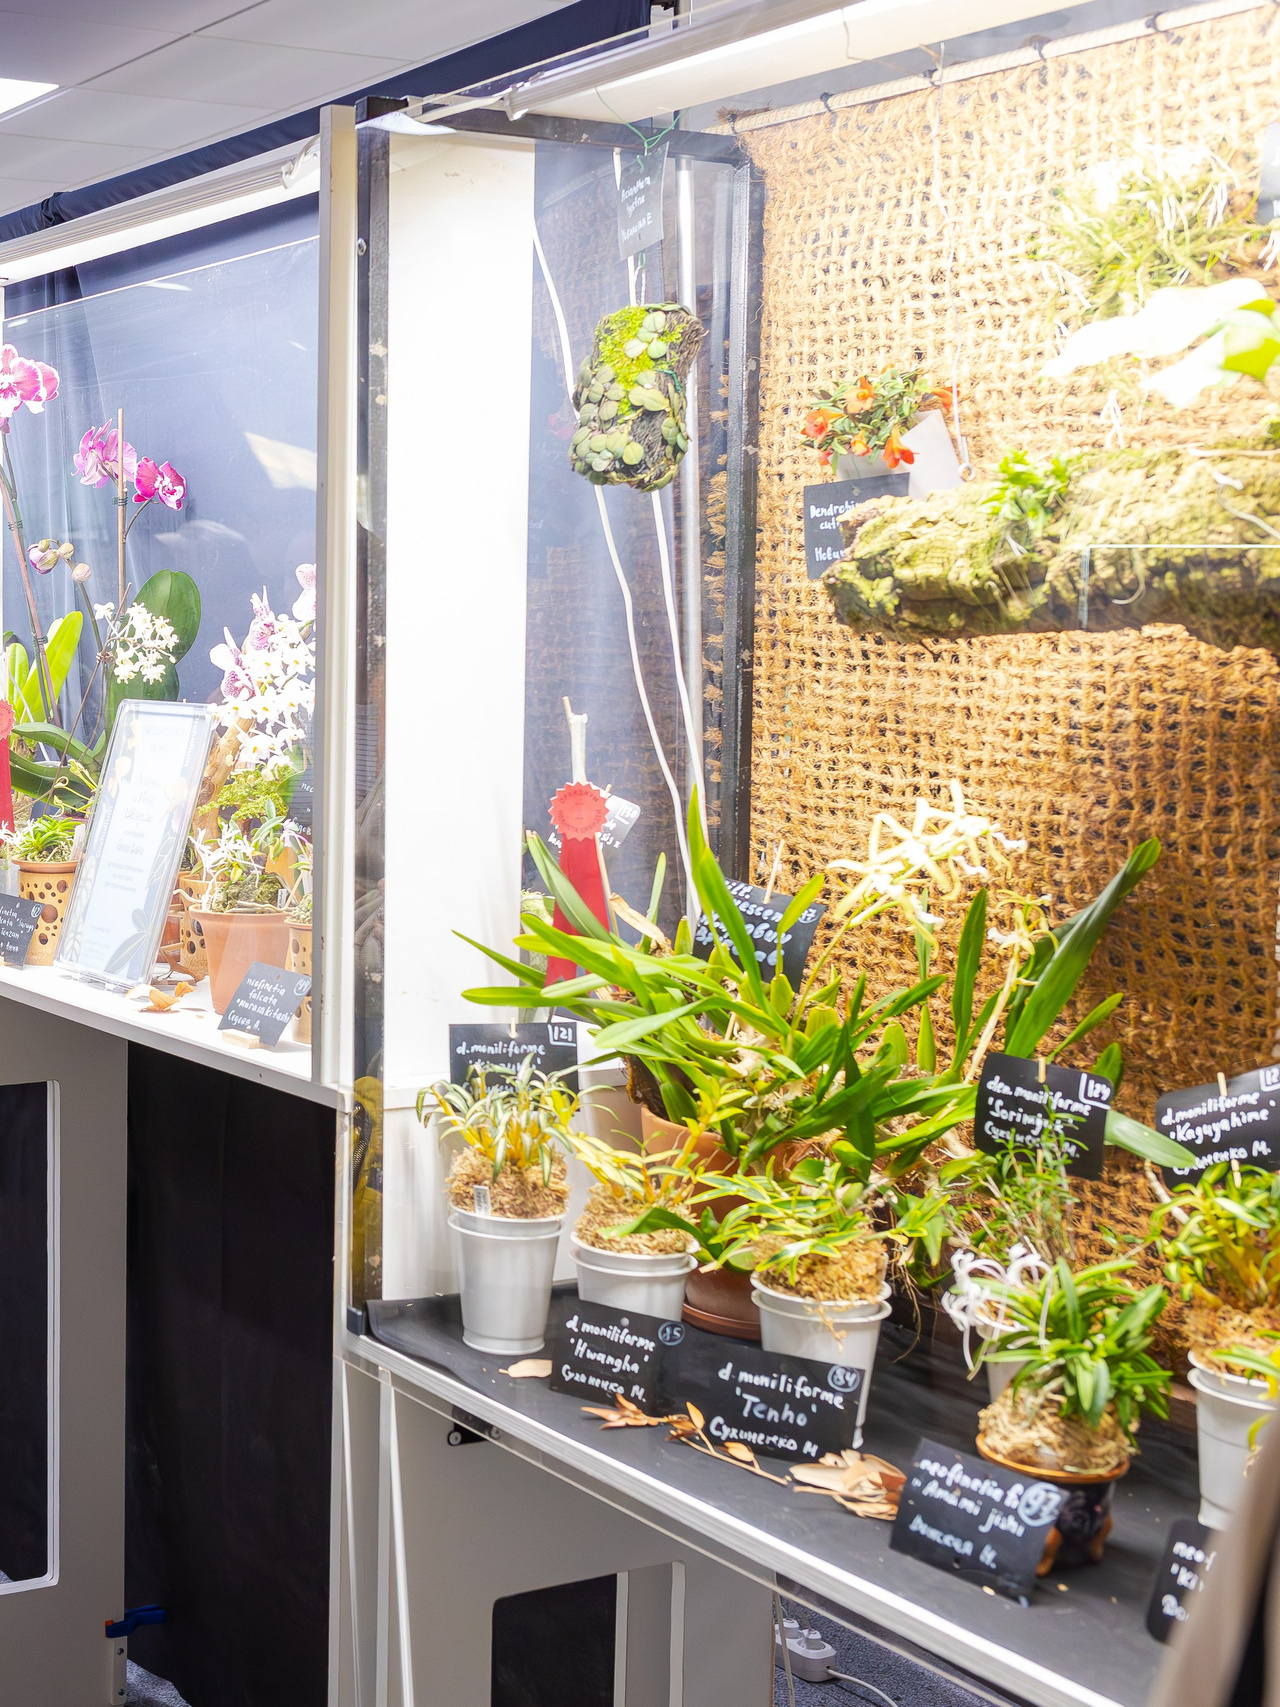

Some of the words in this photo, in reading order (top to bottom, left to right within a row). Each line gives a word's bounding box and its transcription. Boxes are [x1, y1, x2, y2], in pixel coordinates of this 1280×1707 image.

[249, 989, 278, 1006] falcata
[553, 1024, 573, 1042] 121
[738, 1370, 844, 1410] moniliforme
